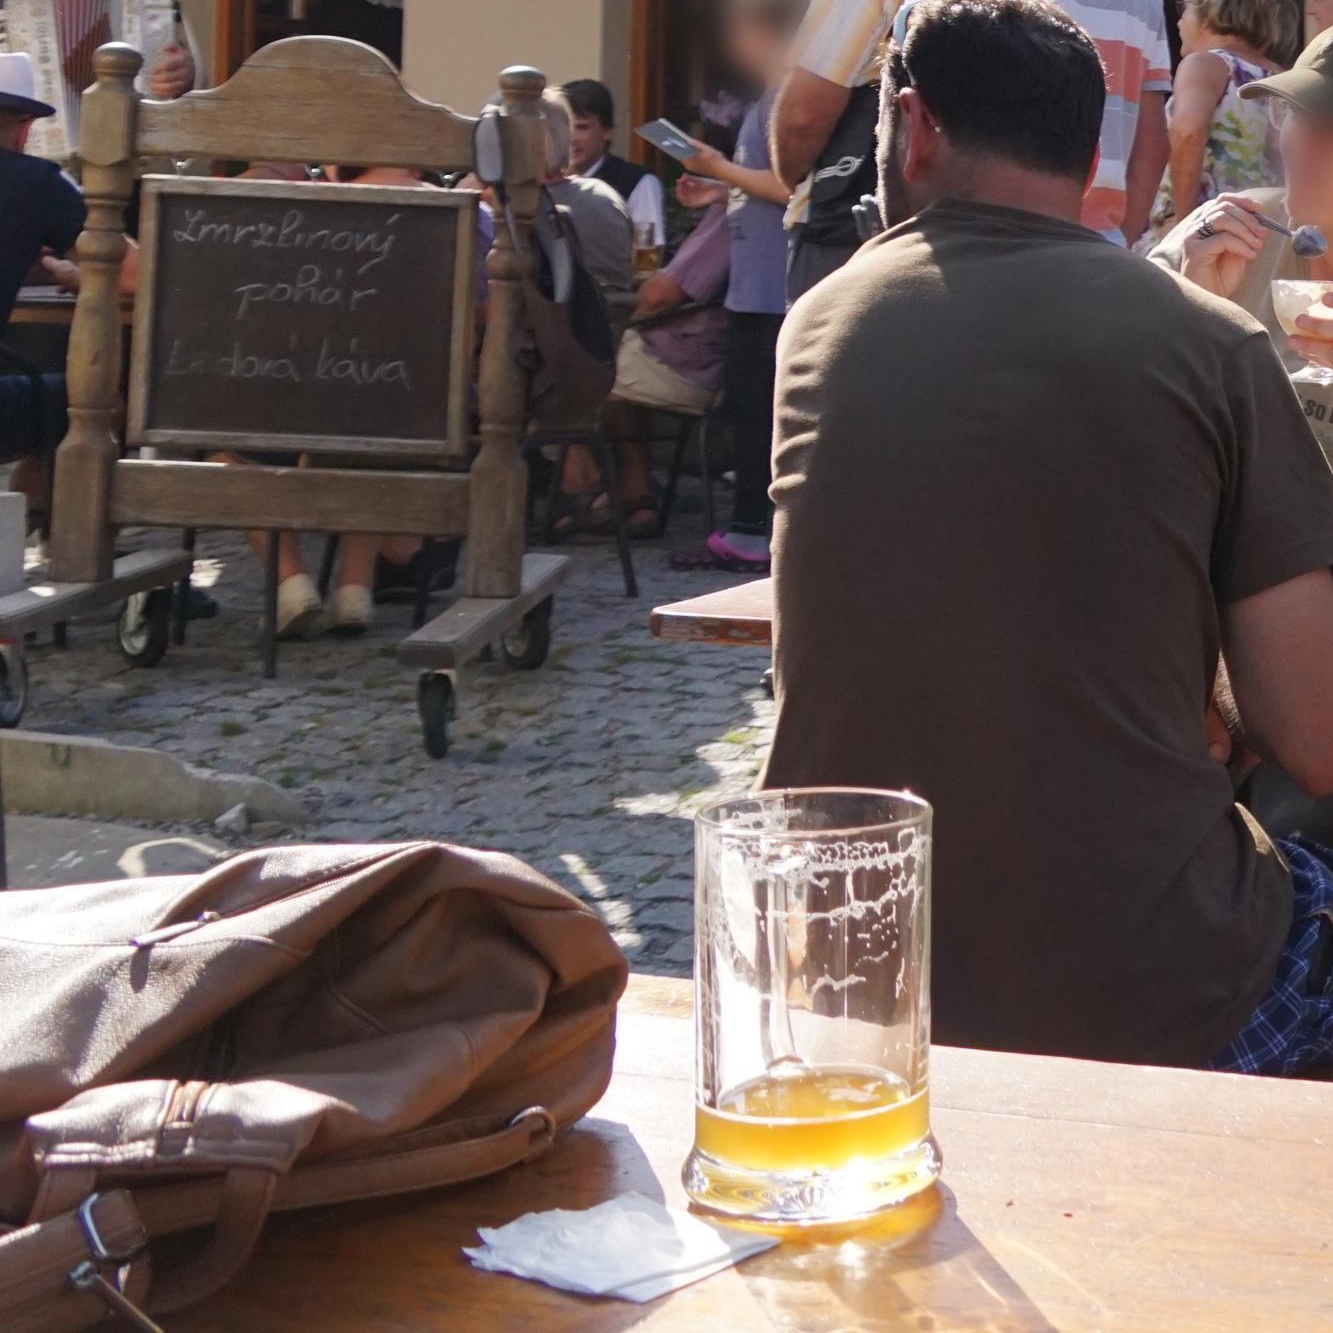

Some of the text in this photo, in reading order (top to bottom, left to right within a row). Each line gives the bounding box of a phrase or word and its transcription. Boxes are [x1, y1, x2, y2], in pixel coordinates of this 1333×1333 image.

[173, 209, 400, 275] Zmrzlinový
[233, 264, 378, 320] pohár
[316, 337, 413, 392] káva
[1304, 399, 1327, 421] so
